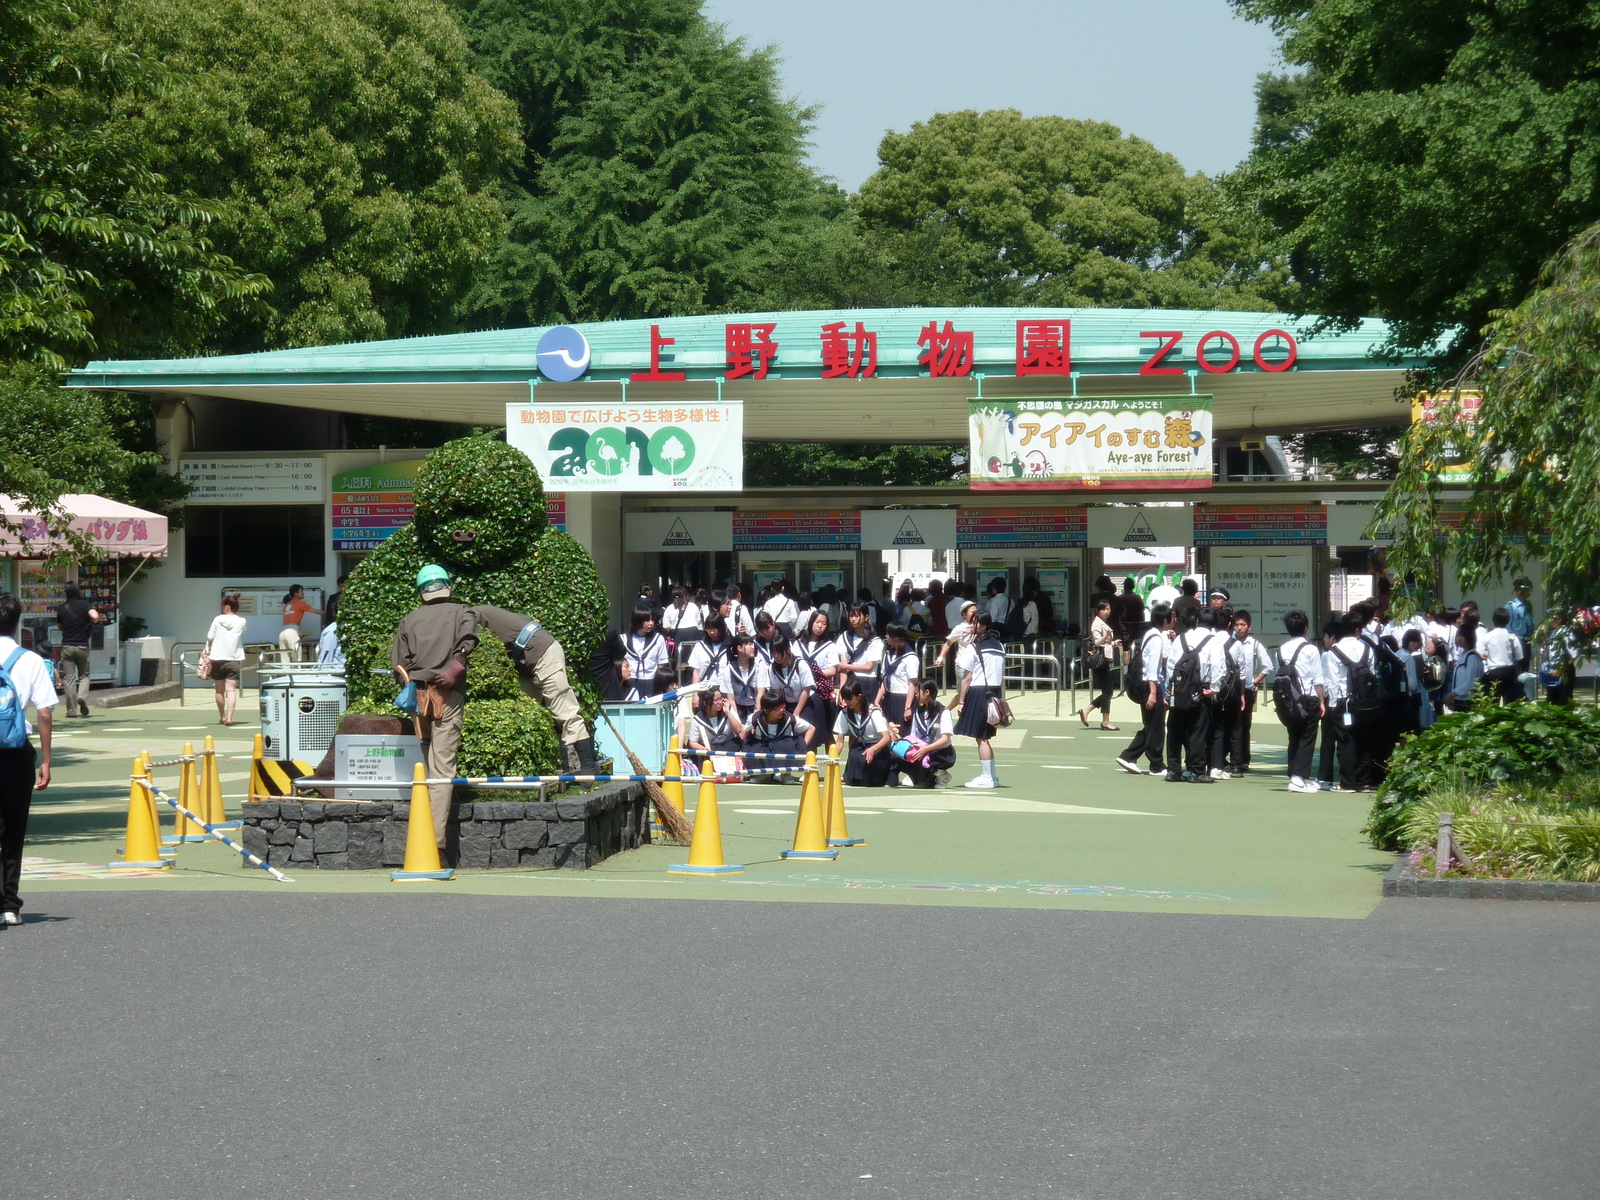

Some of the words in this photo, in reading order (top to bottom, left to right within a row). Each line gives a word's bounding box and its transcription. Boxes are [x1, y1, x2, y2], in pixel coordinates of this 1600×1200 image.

[629, 319, 1071, 382] 上野動物園
[1139, 328, 1297, 375] ZOO
[1018, 418, 1200, 449] アイアイのすむ森
[548, 426, 695, 476] 2010
[1107, 451, 1153, 465] Aye-aye
[1157, 450, 1192, 463] Forest
[341, 477, 373, 489] 入園料
[86, 518, 148, 541] パンダ焼
[341, 518, 360, 527] 中学生
[364, 748, 405, 758] 上野動物園
